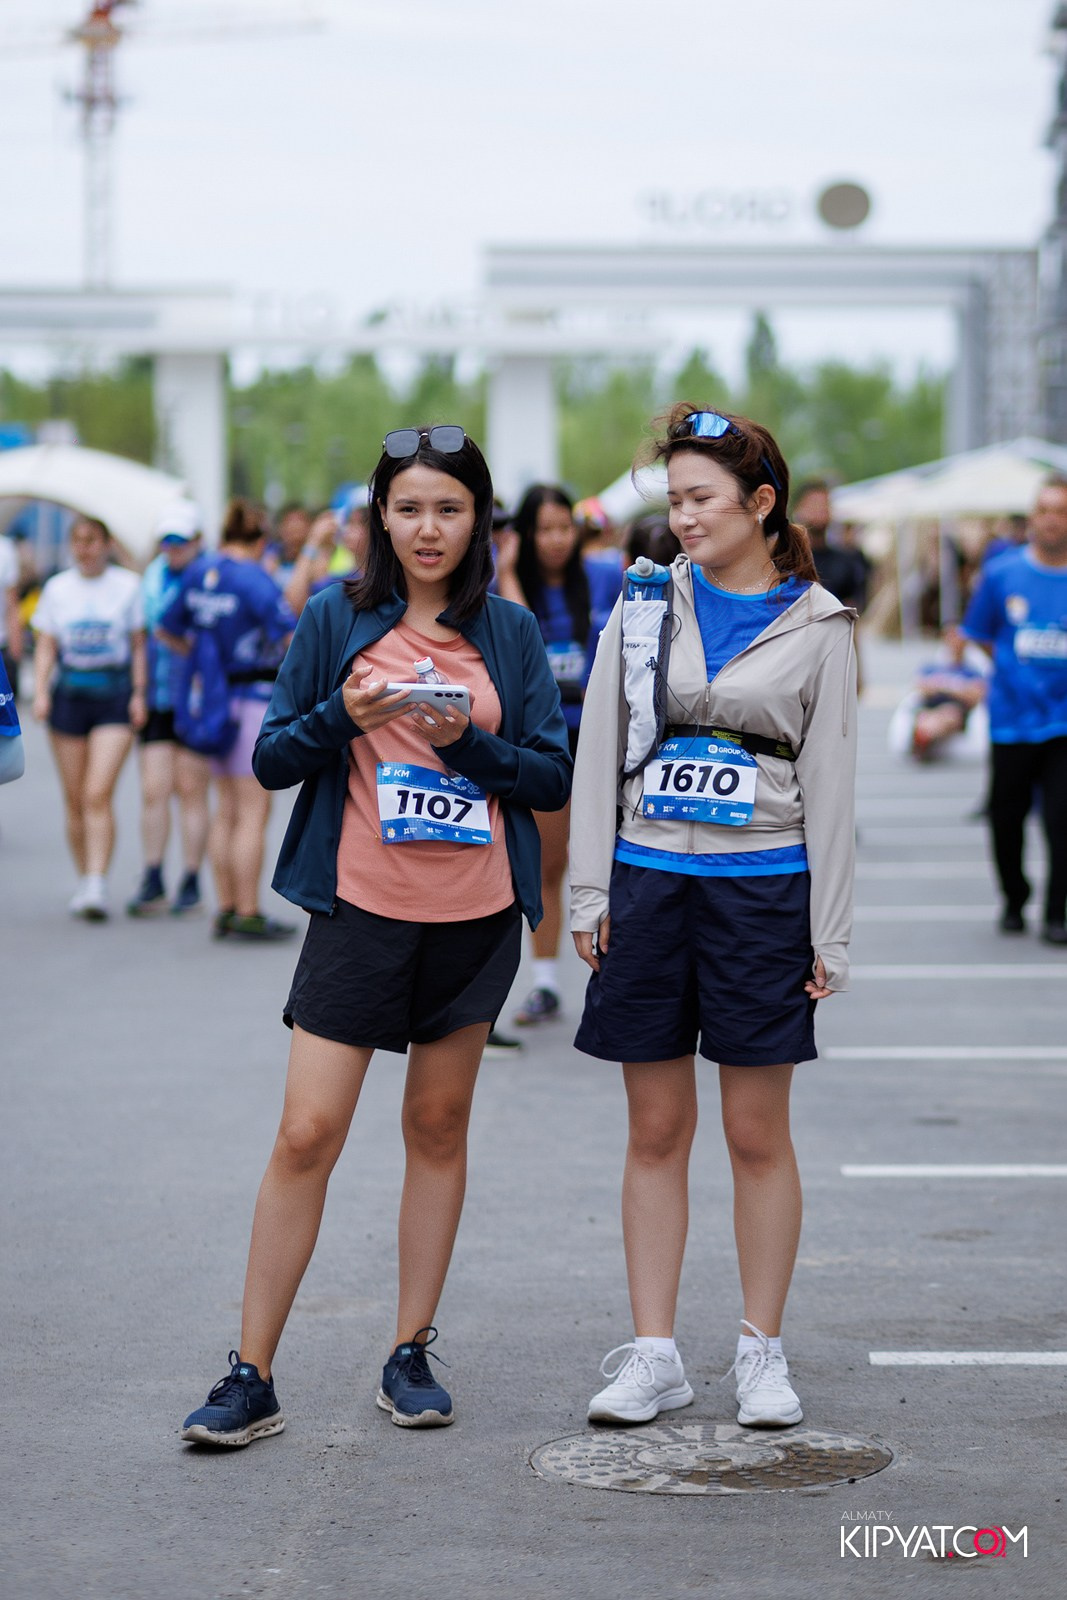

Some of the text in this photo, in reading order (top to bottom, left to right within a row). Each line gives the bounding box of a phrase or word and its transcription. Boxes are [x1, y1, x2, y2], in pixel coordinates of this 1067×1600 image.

[663, 743, 679, 751] KM
[718, 746, 741, 755] GROUP
[382, 766, 410, 778] 5 KM
[659, 762, 740, 796] 1610
[397, 789, 473, 823] 1107
